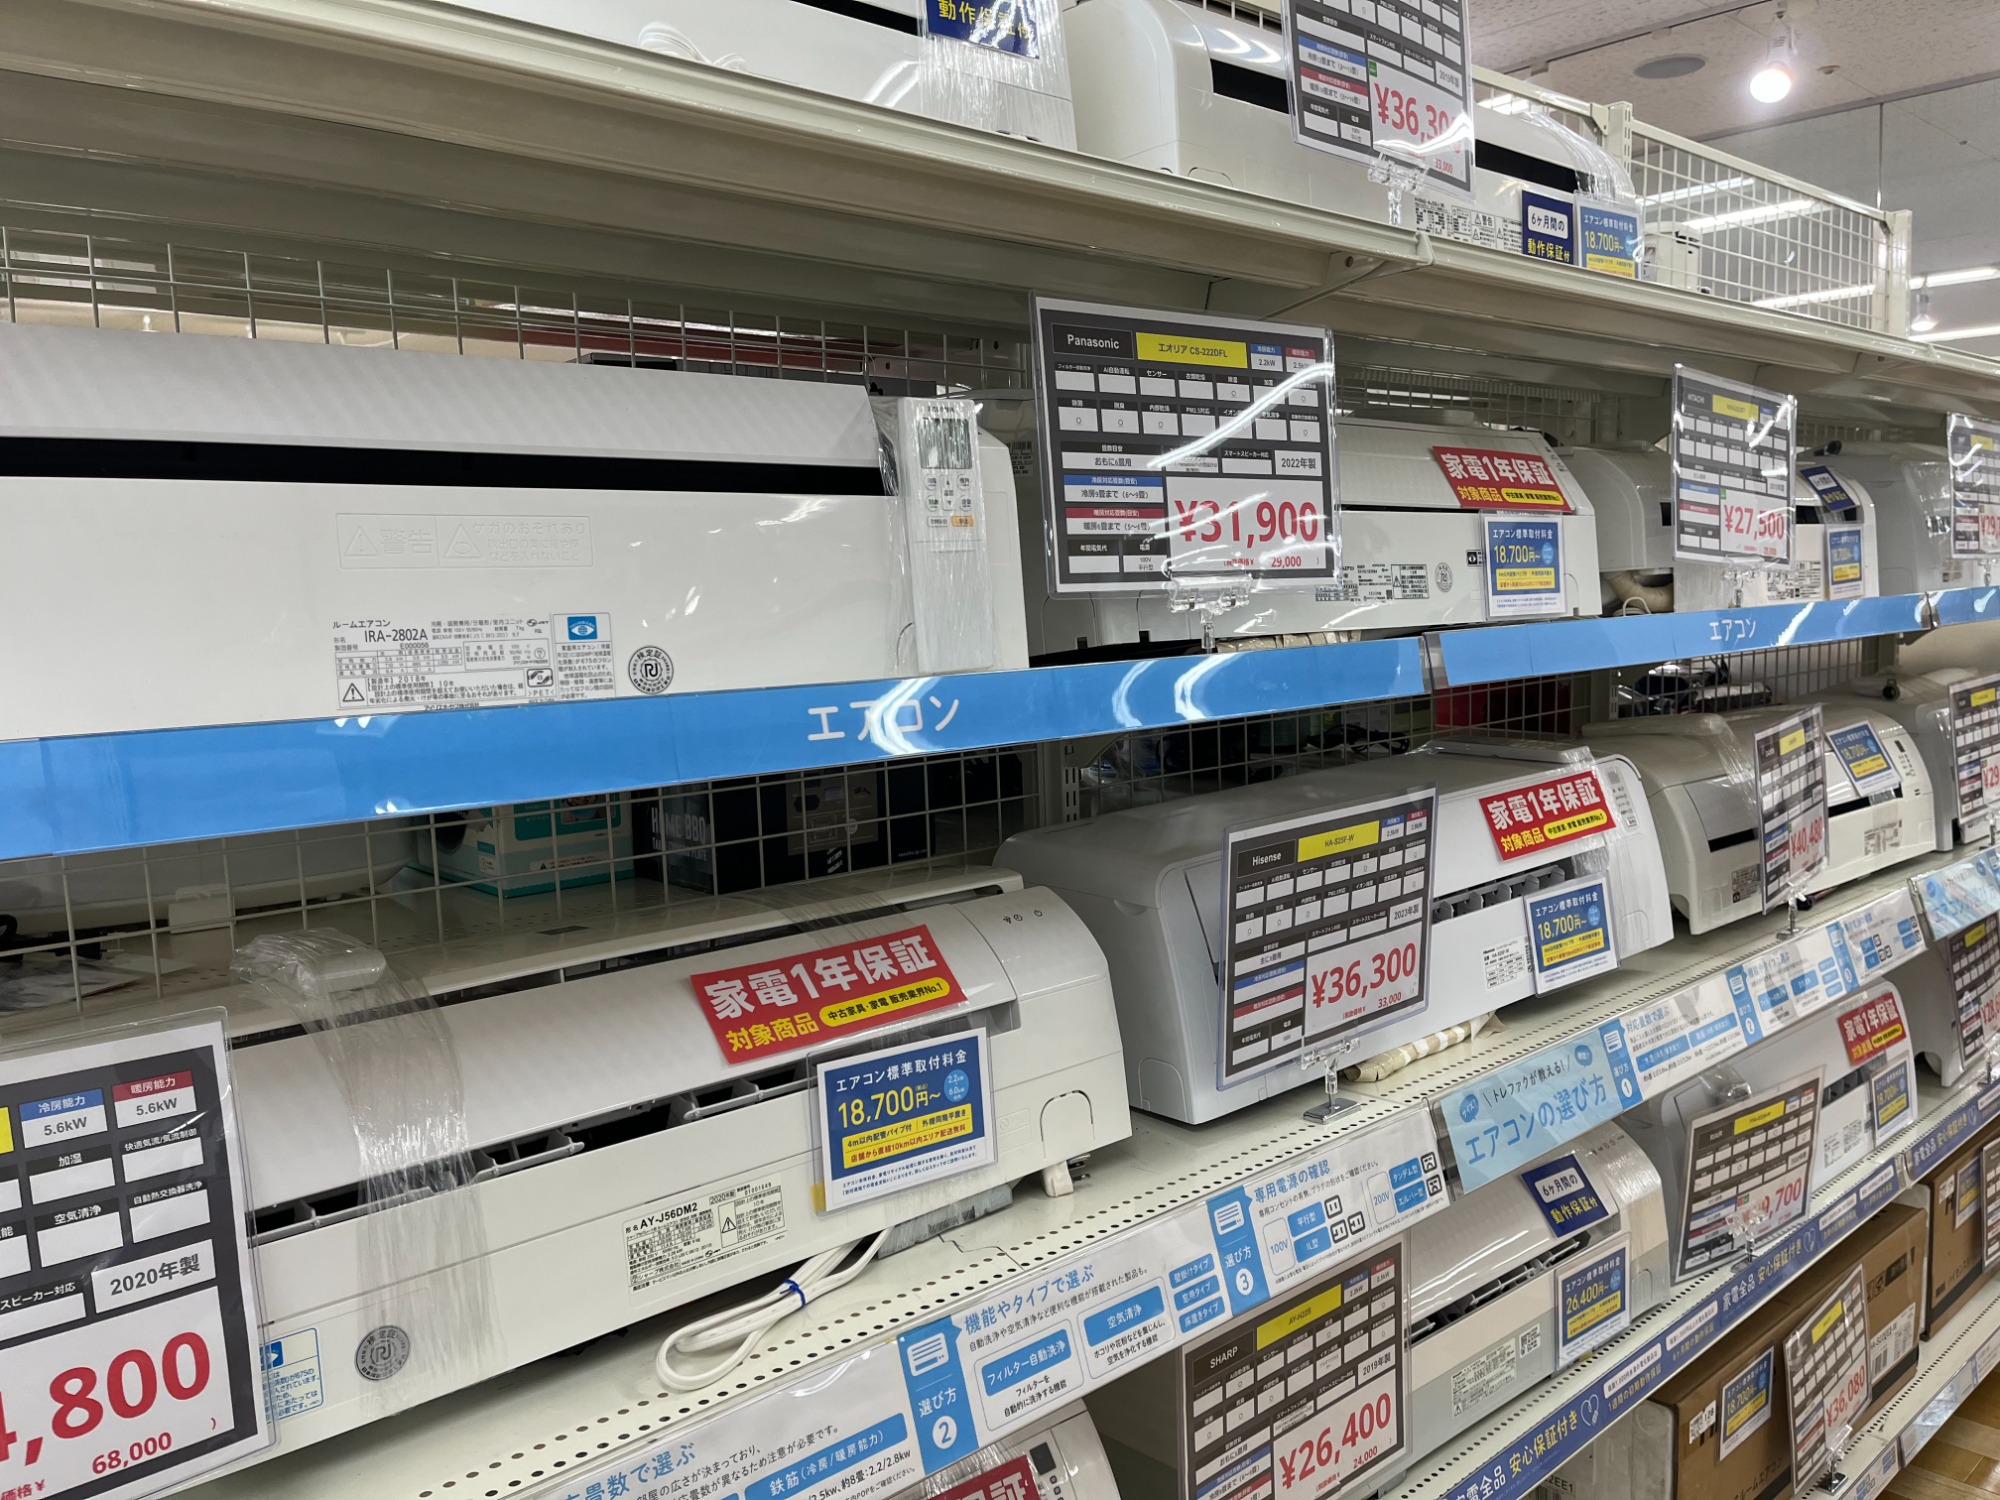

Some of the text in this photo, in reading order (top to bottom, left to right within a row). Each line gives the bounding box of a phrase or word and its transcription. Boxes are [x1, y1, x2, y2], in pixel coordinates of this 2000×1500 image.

[1527, 238, 1570, 263] 動作保証付
[1067, 334, 1120, 350] Panasonic
[1158, 343, 1188, 355] エオリア
[1146, 370, 1168, 378] センサー
[1281, 457, 1316, 470] 2022年製
[1441, 453, 1555, 486] 家電1年保証
[1457, 485, 1503, 502] 対象商品
[472, 521, 586, 535] ケガのおそれあり
[1174, 499, 1318, 549] ¥31,900
[1724, 504, 1785, 541] ¥27,500
[379, 528, 434, 555] 警告
[1271, 556, 1301, 568] 29,000
[333, 620, 391, 629] ルームエアコン
[364, 629, 428, 643] IRA-2802A
[1709, 618, 1757, 641] エアコン
[1487, 776, 1601, 831] 家電1年保証
[651, 807, 682, 839] HME
[1500, 827, 1545, 853] 対象商品
[1252, 852, 1282, 866] Hisense
[1394, 904, 1419, 920] 2023年製
[704, 934, 938, 1021] 家電1年保証
[1311, 942, 1416, 1009] ¥36,300
[1377, 991, 1402, 1009] 33,000
[725, 1012, 820, 1053] 対象商品
[1844, 999, 1899, 1042] 家電1年保証
[836, 1049, 967, 1093] エアコン標準取付料金
[130, 1077, 176, 1095] 暖房能力
[38, 1095, 86, 1114] 冷房能力
[136, 1097, 178, 1117] 5.6kW
[44, 1116, 88, 1137] 5.6kW
[1465, 1073, 1606, 1165] エアコンの選び方
[124, 1127, 197, 1152] 快適気流/気流制御
[847, 1124, 912, 1148] 4m以内配管パイプ付
[58, 1152, 82, 1167] 加湿
[133, 1180, 203, 1205] 自動熱交換器洗浄
[1253, 1159, 1331, 1204] 専用電源の確認
[1373, 1191, 1390, 1206] 200V
[54, 1204, 102, 1225] 空気清浄
[640, 1202, 698, 1230] AY-J56DM2
[1550, 1198, 1598, 1225] 動作保証付
[1224, 1245, 1252, 1269] 選び方
[1270, 1239, 1289, 1256] 100V
[110, 1253, 201, 1297] 2020年製
[1173, 1258, 1210, 1283] 壁掛けタイプ
[1239, 1272, 1250, 1291] 3
[1722, 1239, 1802, 1313] 家電全品 安心保証付き
[965, 1265, 1095, 1336] 機能やタイプで選ぶ
[1182, 1281, 1212, 1304] 窓用タイプ
[1107, 1305, 1142, 1328] 空気清浄
[987, 1340, 1066, 1387] フィルター自動洗浄
[1210, 1346, 1238, 1369] SHARP
[1362, 1353, 1391, 1377] 2019年製
[1015, 1374, 1050, 1397] フィルターを
[1825, 1364, 1866, 1428] ¥36,080
[918, 1387, 957, 1418] 選び方
[1004, 1379, 1067, 1418] 自動的に洗浄する機能
[938, 1420, 951, 1445] 2
[1279, 1392, 1391, 1490] ¥26,400
[1509, 1410, 1578, 1479] 安心保証付き
[91, 1432, 173, 1475] 68,000
[1352, 1446, 1378, 1469] 24,000
